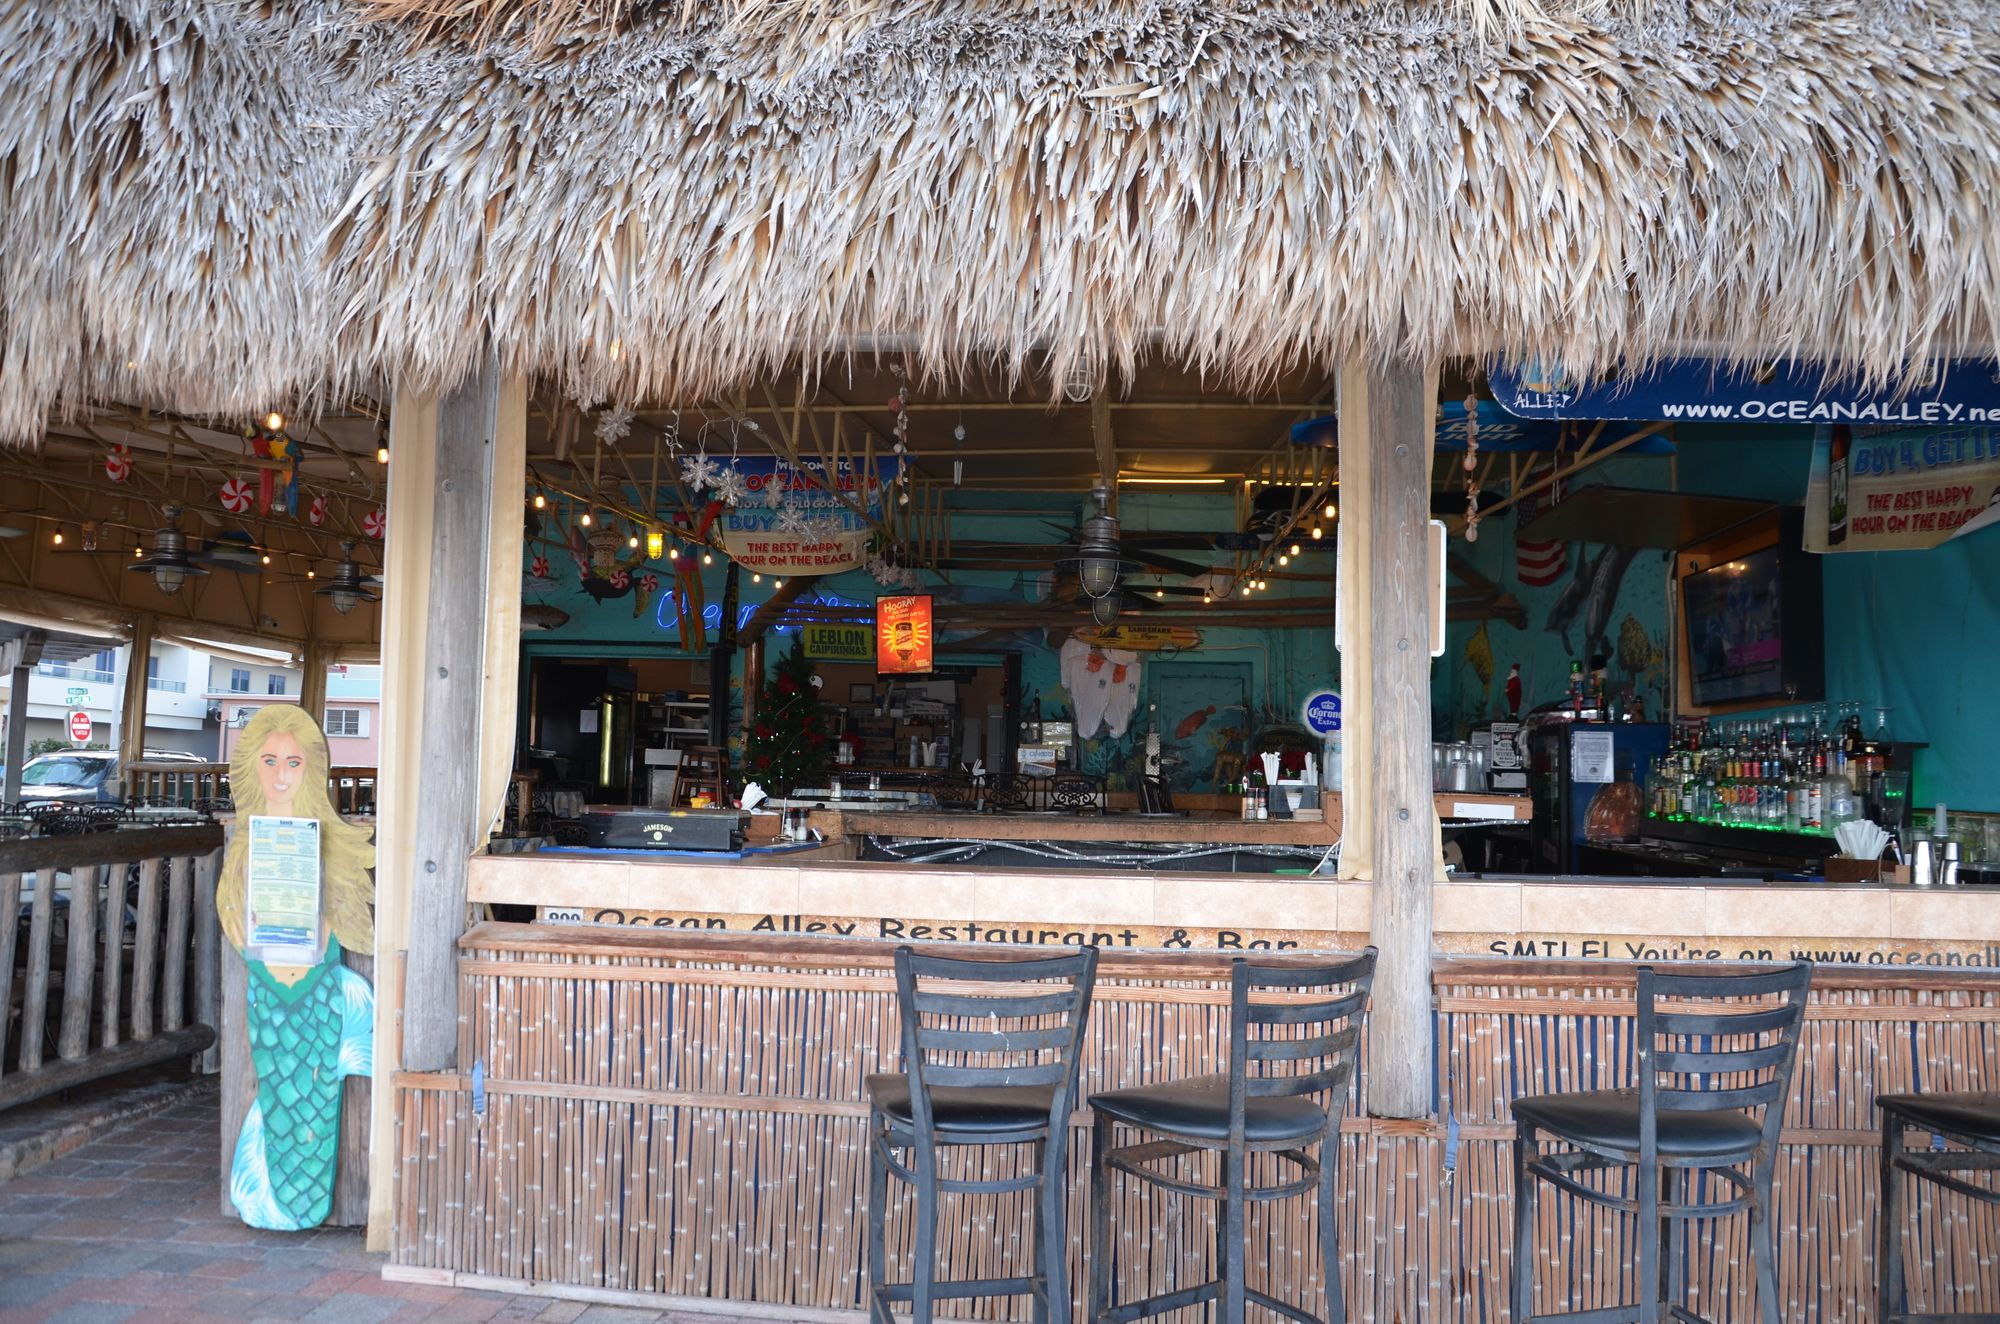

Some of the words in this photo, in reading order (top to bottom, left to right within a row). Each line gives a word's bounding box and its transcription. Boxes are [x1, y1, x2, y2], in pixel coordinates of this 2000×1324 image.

[1662, 400, 2000, 422] www.OCEANALLEY.ne
[1854, 445, 1897, 475] BUY
[1923, 430, 1967, 466] GET
[1867, 494, 1892, 511] THE
[1894, 490, 1924, 510] BEST
[1926, 485, 1974, 508] HAPPY
[728, 513, 775, 531] BUY
[1852, 516, 1883, 535] HOUR
[1887, 515, 1908, 532] ON
[1912, 512, 1936, 531] THE
[747, 543, 768, 553] THE
[772, 543, 799, 553] BEST
[802, 543, 842, 553] HAPPY
[735, 555, 766, 566] HOUR
[769, 556, 786, 566] ON
[790, 556, 812, 566] THE
[883, 596, 916, 613] HOORAY
[811, 628, 865, 645] LEBLON
[809, 644, 867, 657] CAIPIRINHAS
[1308, 707, 1341, 719] Coron
[1317, 718, 1337, 726] Extra
[643, 823, 674, 832] JAMESON
[594, 909, 726, 929] Ocean
[752, 915, 856, 935] Alley
[880, 918, 1138, 946] Restaurant
[1163, 929, 1191, 949] &
[1218, 931, 1298, 950] Bar
[1739, 949, 1772, 960] on
[1790, 946, 2000, 967] wwwoceanall
